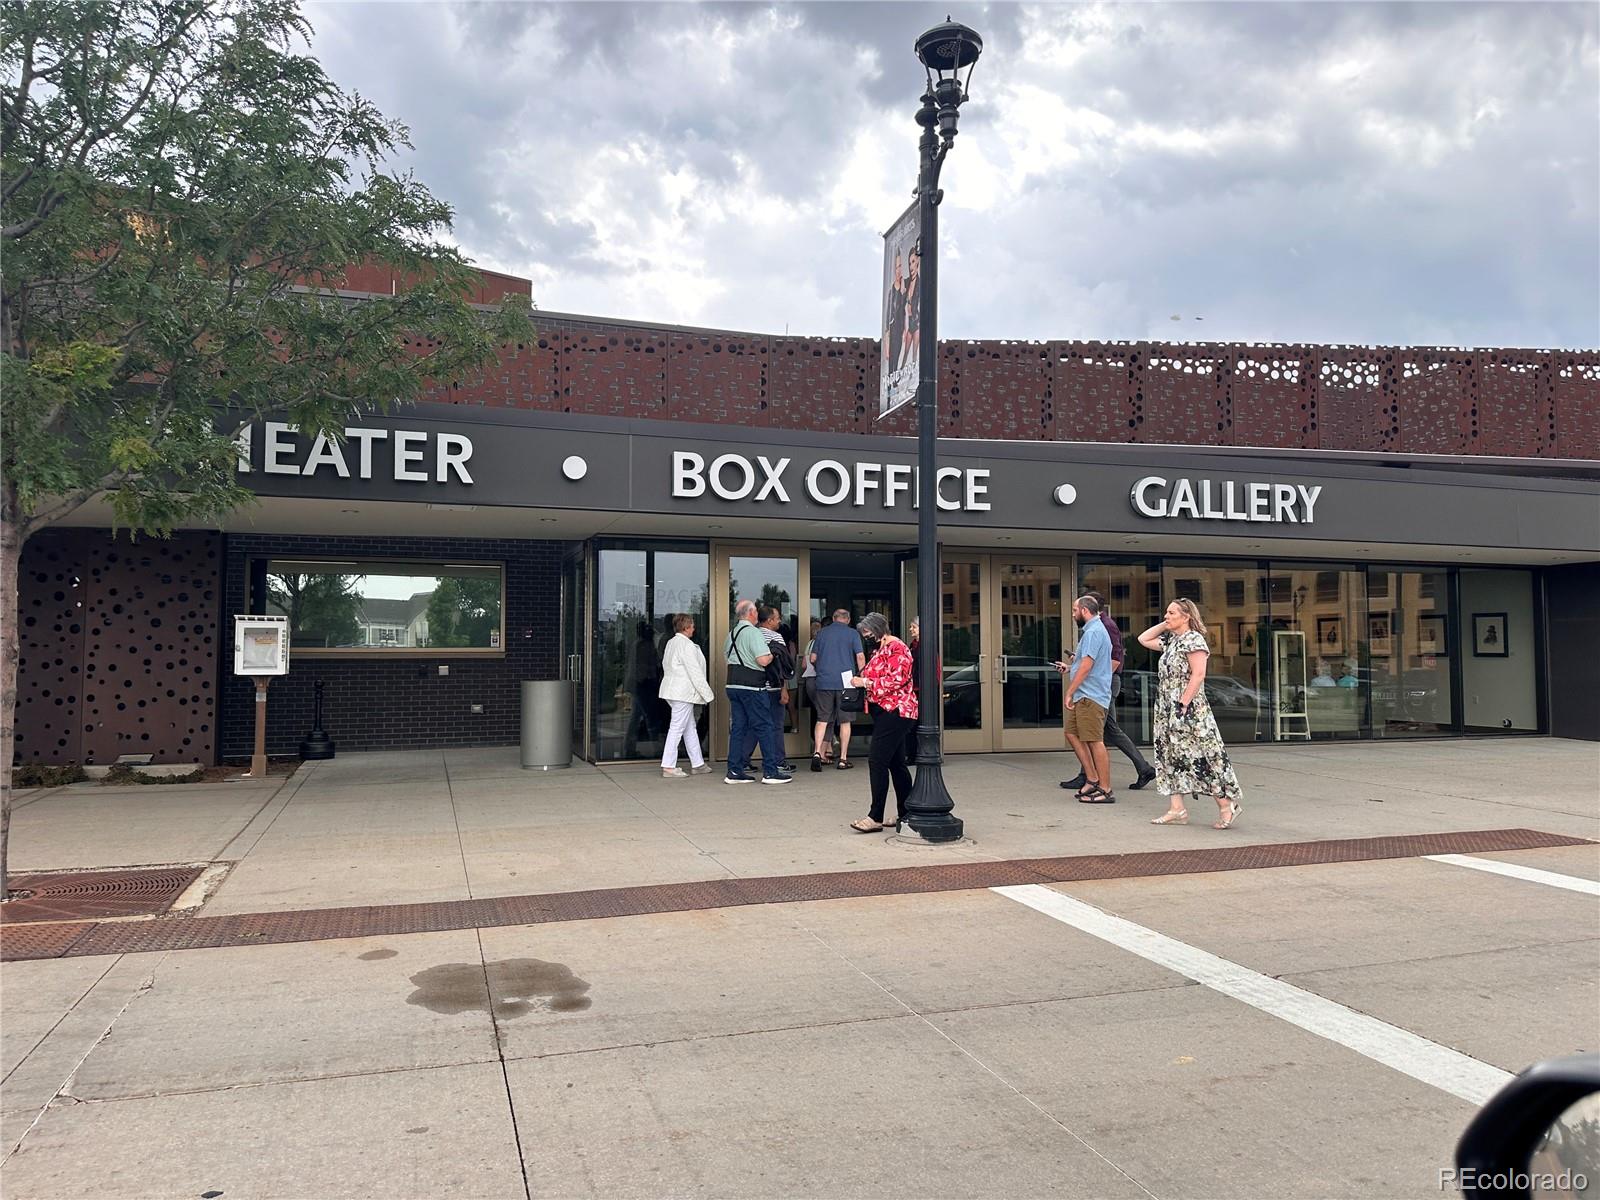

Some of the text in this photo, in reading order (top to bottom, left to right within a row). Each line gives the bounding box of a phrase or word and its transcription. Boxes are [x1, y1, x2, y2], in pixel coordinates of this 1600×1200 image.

[195, 417, 474, 485] HEATER
[672, 450, 791, 503] BOX
[1130, 475, 1322, 524] GALLERY
